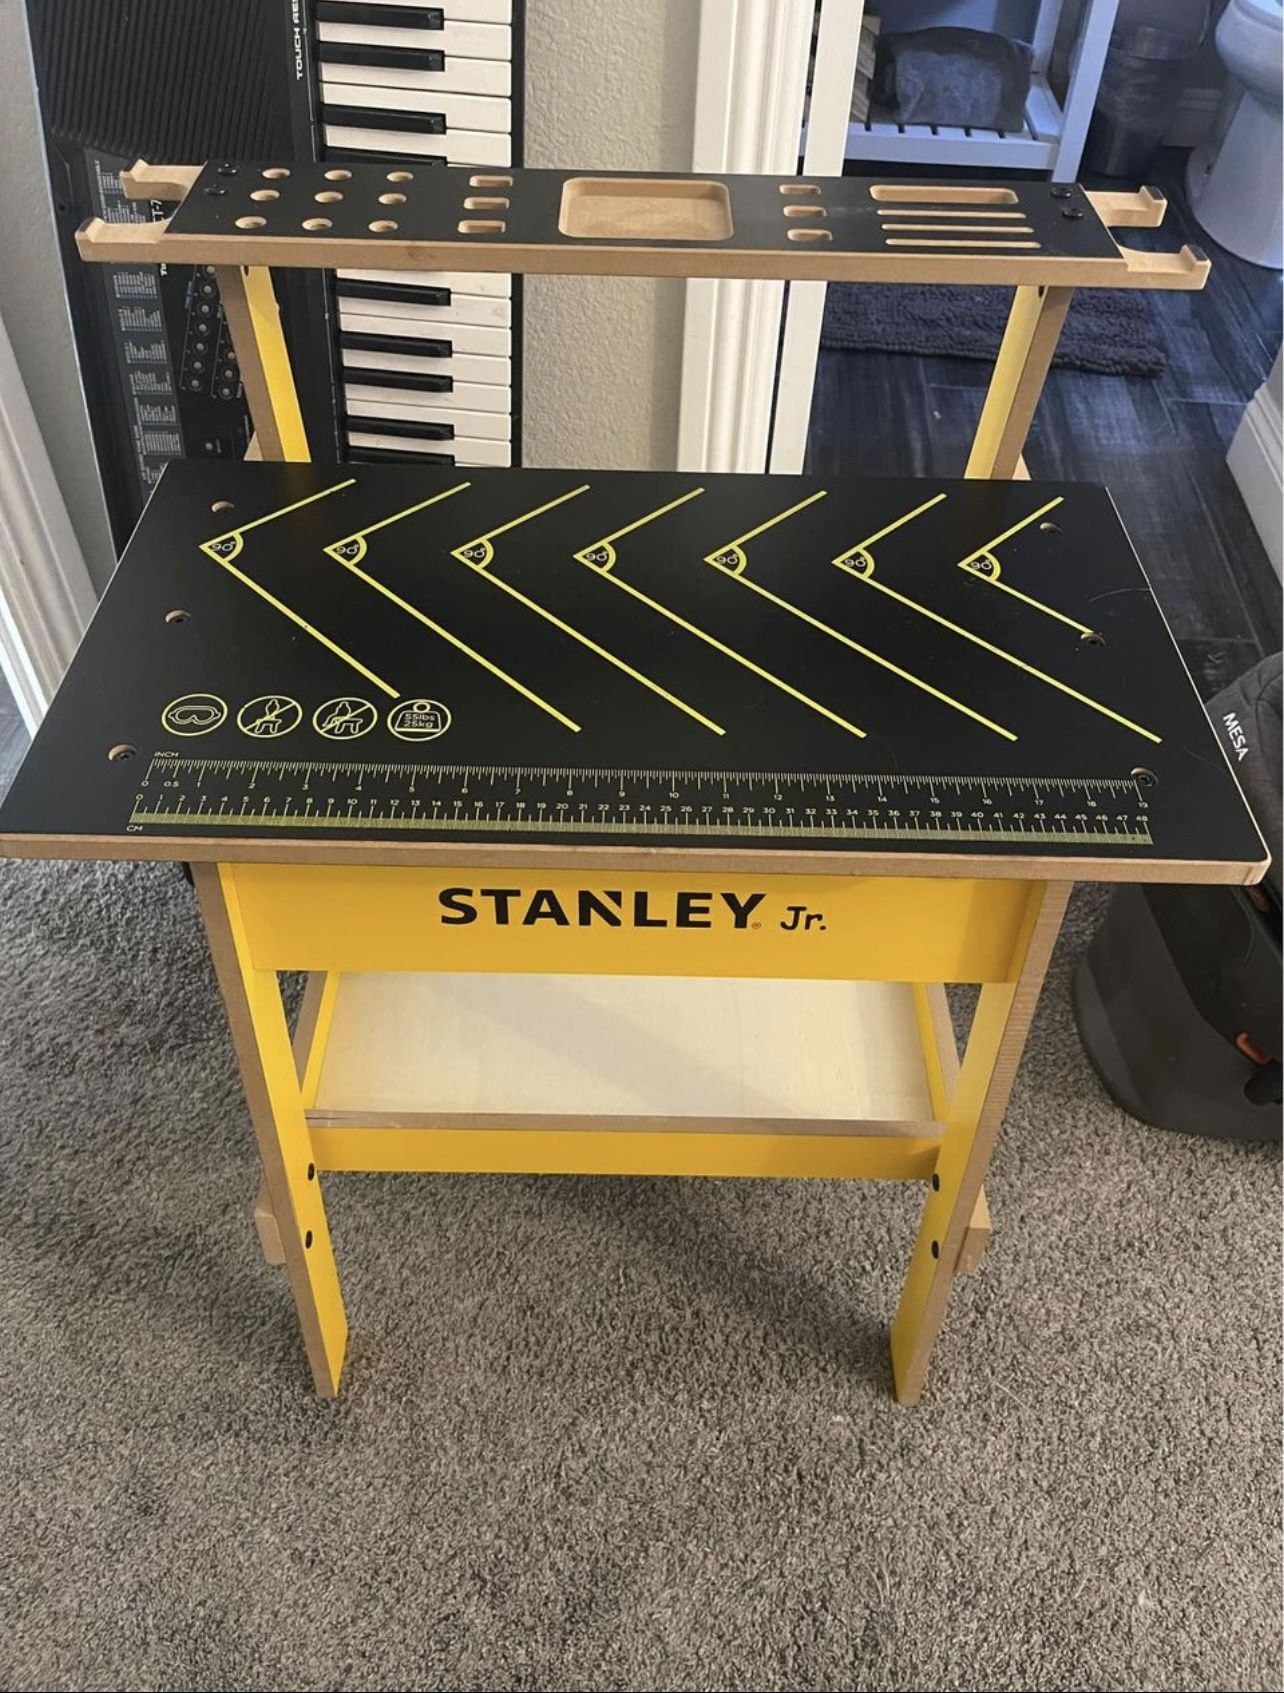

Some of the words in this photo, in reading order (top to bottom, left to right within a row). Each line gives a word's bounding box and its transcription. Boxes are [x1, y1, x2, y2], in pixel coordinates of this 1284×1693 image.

[293, 27, 303, 80] TOUCH
[404, 720, 433, 728] 25kg
[1223, 712, 1248, 762] MESA
[780, 906, 827, 930] Jr.
